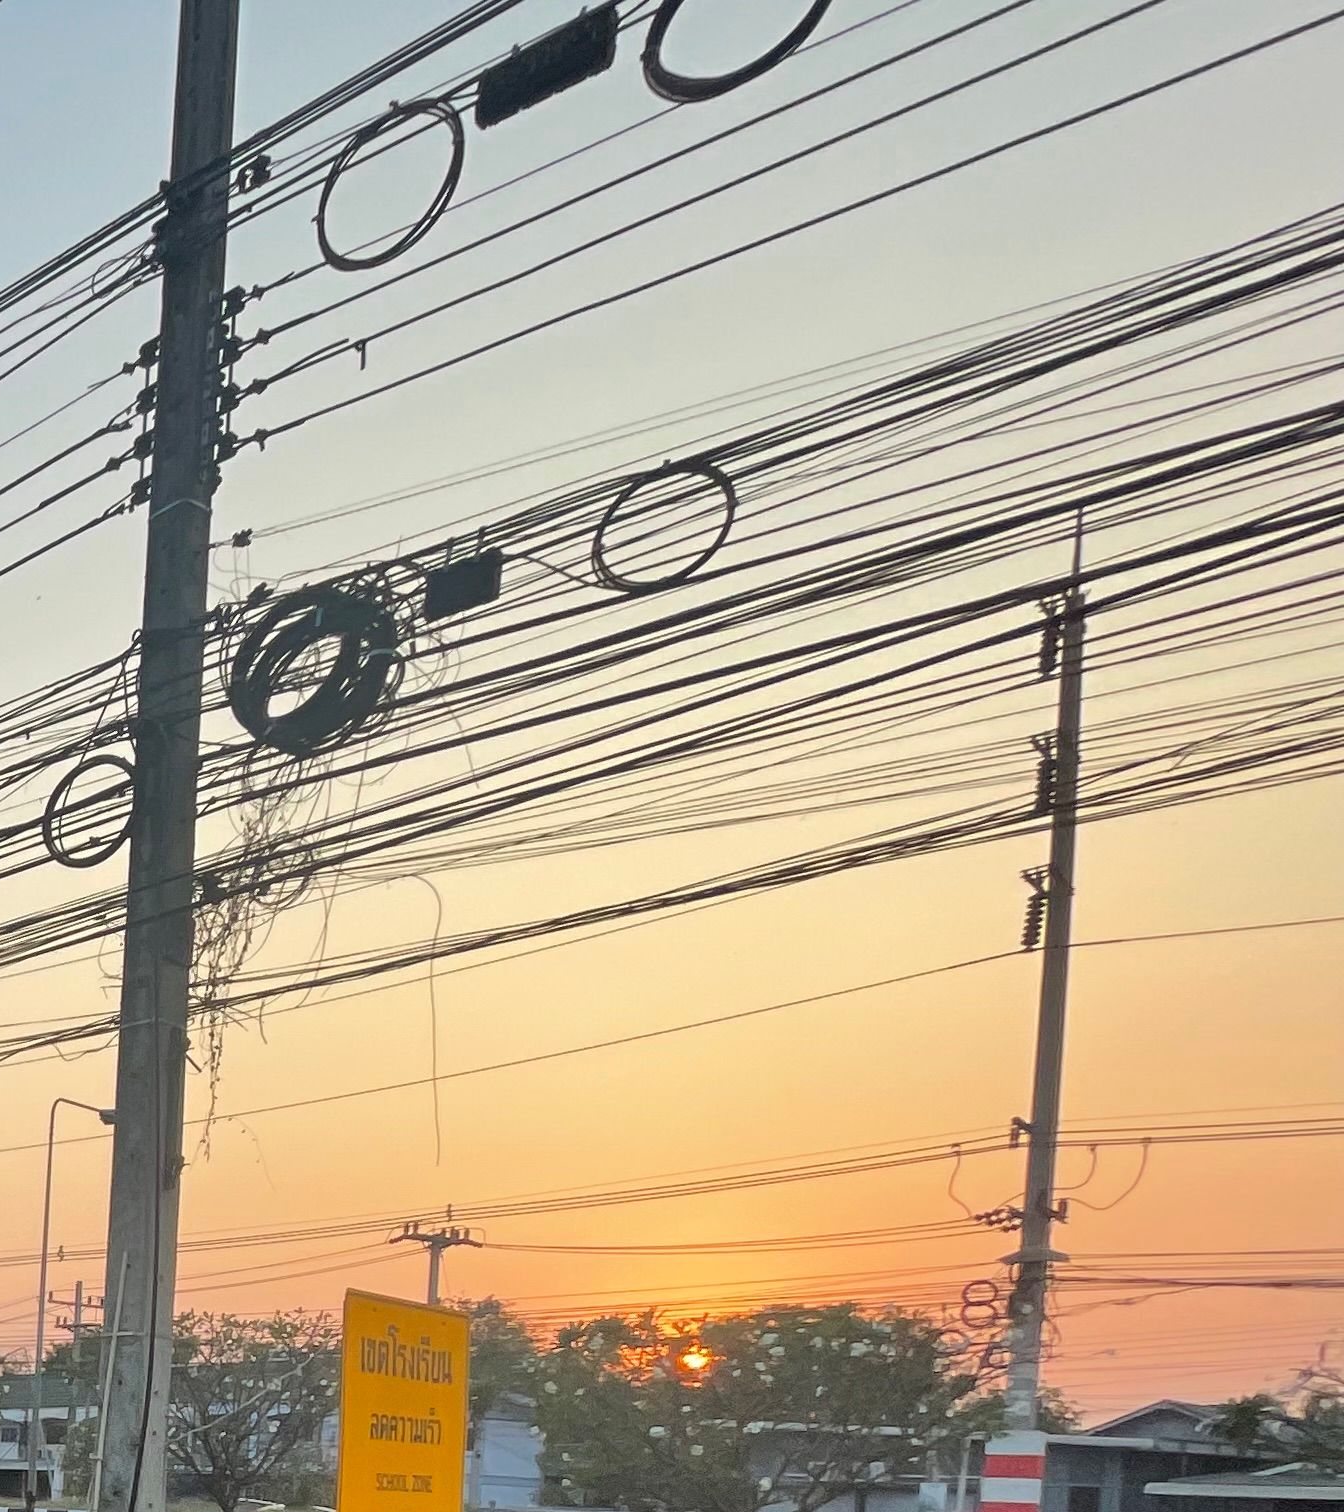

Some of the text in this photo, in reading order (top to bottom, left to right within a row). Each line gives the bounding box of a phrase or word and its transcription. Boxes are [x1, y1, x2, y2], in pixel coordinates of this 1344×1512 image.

[361, 1324, 452, 1383] เขตโรงเรียน
[370, 1408, 441, 1445] ลดความเร็ว
[376, 1473, 433, 1493] SCHOOL ZONE
